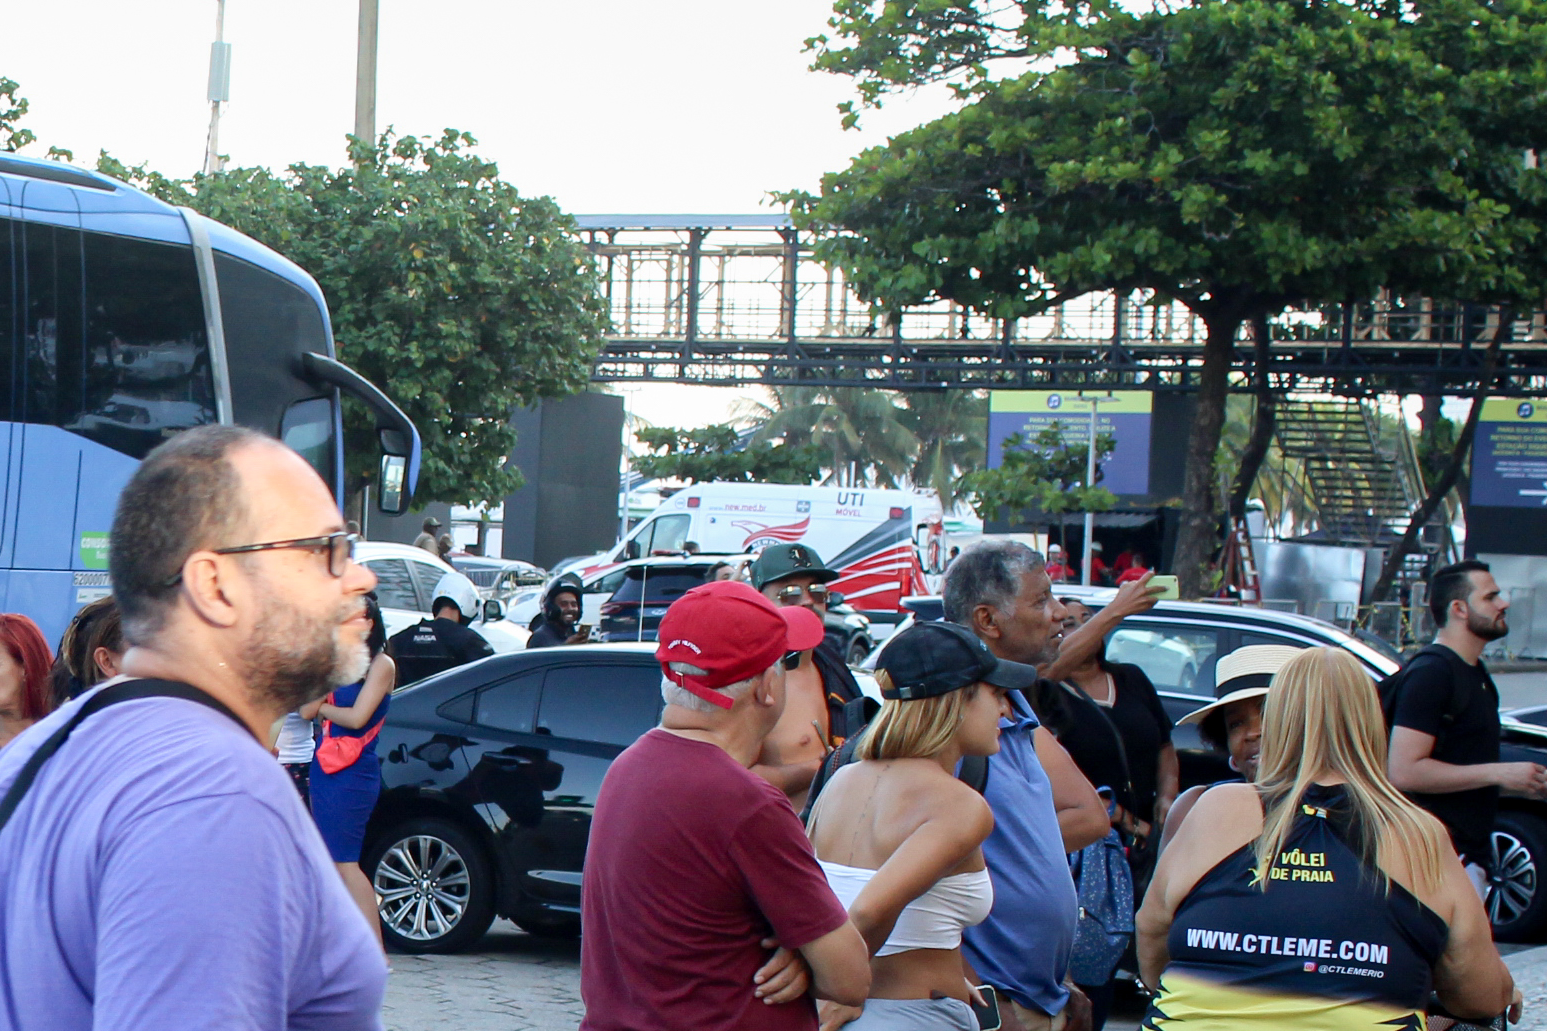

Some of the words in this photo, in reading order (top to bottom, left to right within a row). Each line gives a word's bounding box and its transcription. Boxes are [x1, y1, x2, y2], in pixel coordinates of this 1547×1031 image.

[837, 492, 865, 506] UTI
[835, 507, 862, 517] MÓVEL
[1281, 848, 1325, 867] VÔLEI
[1270, 867, 1289, 881] DE
[1292, 868, 1334, 882] PRAIA
[1187, 928, 1389, 965] WWW.CTLEME.COM
[1318, 964, 1385, 979] @CTLEMERIO
